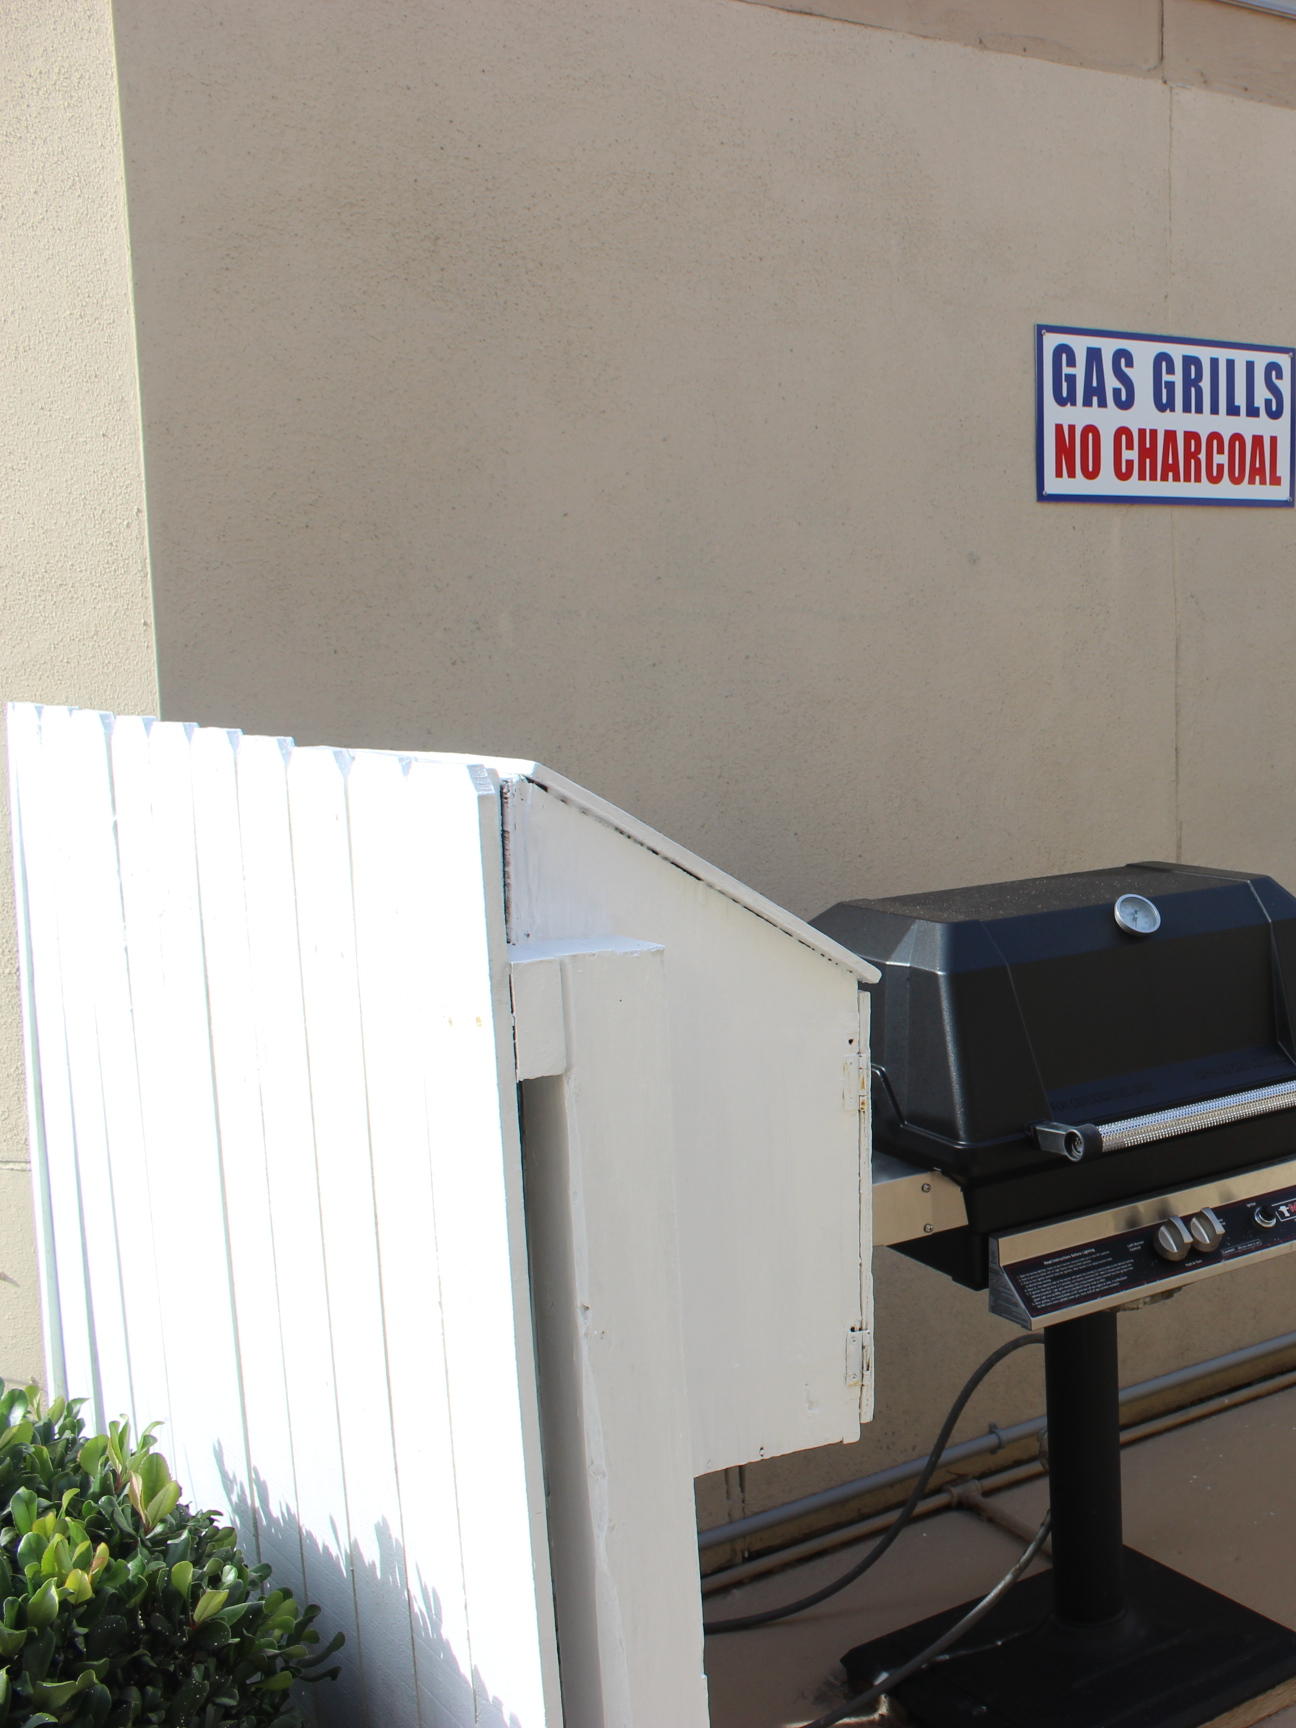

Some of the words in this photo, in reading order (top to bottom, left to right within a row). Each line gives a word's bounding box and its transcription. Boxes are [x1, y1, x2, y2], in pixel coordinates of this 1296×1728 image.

[1052, 343, 1135, 411] GAS
[1152, 351, 1284, 420] GRILLS
[1054, 423, 1101, 480] NO
[1113, 426, 1282, 486] CHARCOAL
